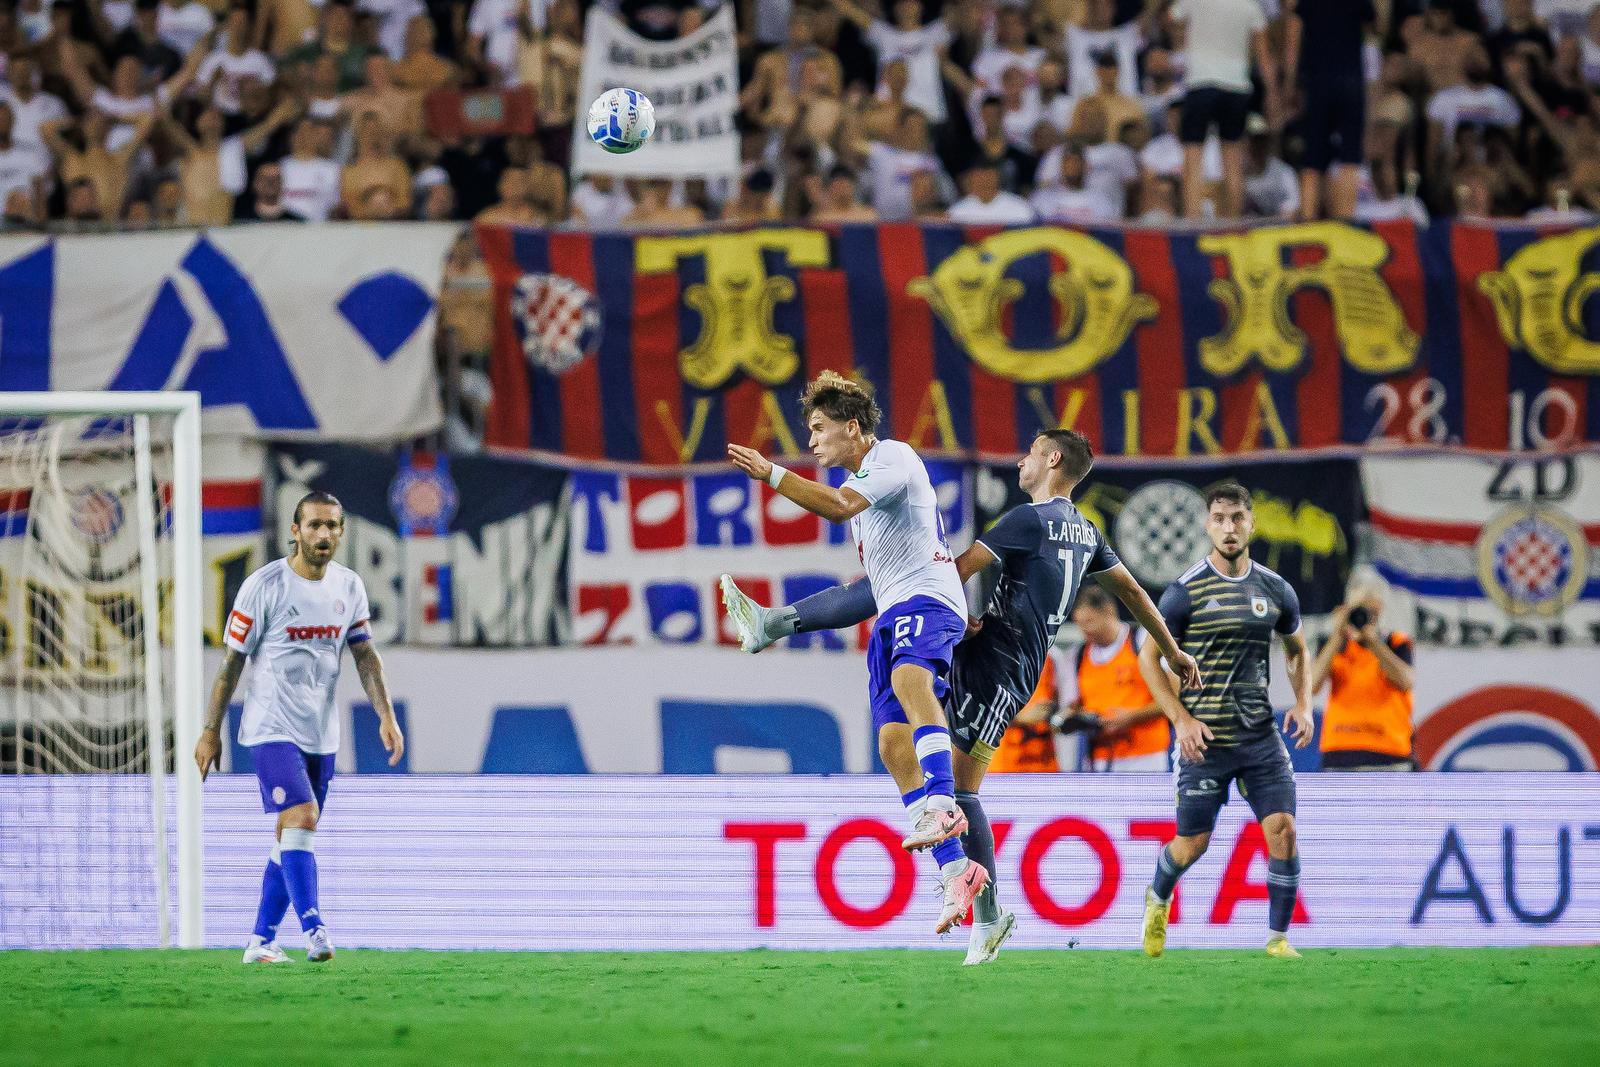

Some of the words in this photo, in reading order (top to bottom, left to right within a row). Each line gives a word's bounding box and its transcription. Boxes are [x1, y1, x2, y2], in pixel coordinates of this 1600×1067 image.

[1027, 380, 1292, 458] VIRA
[286, 625, 342, 641] TOMMY
[894, 615, 924, 638] 21
[957, 692, 986, 731] 11
[723, 816, 1311, 929] TOOTA
